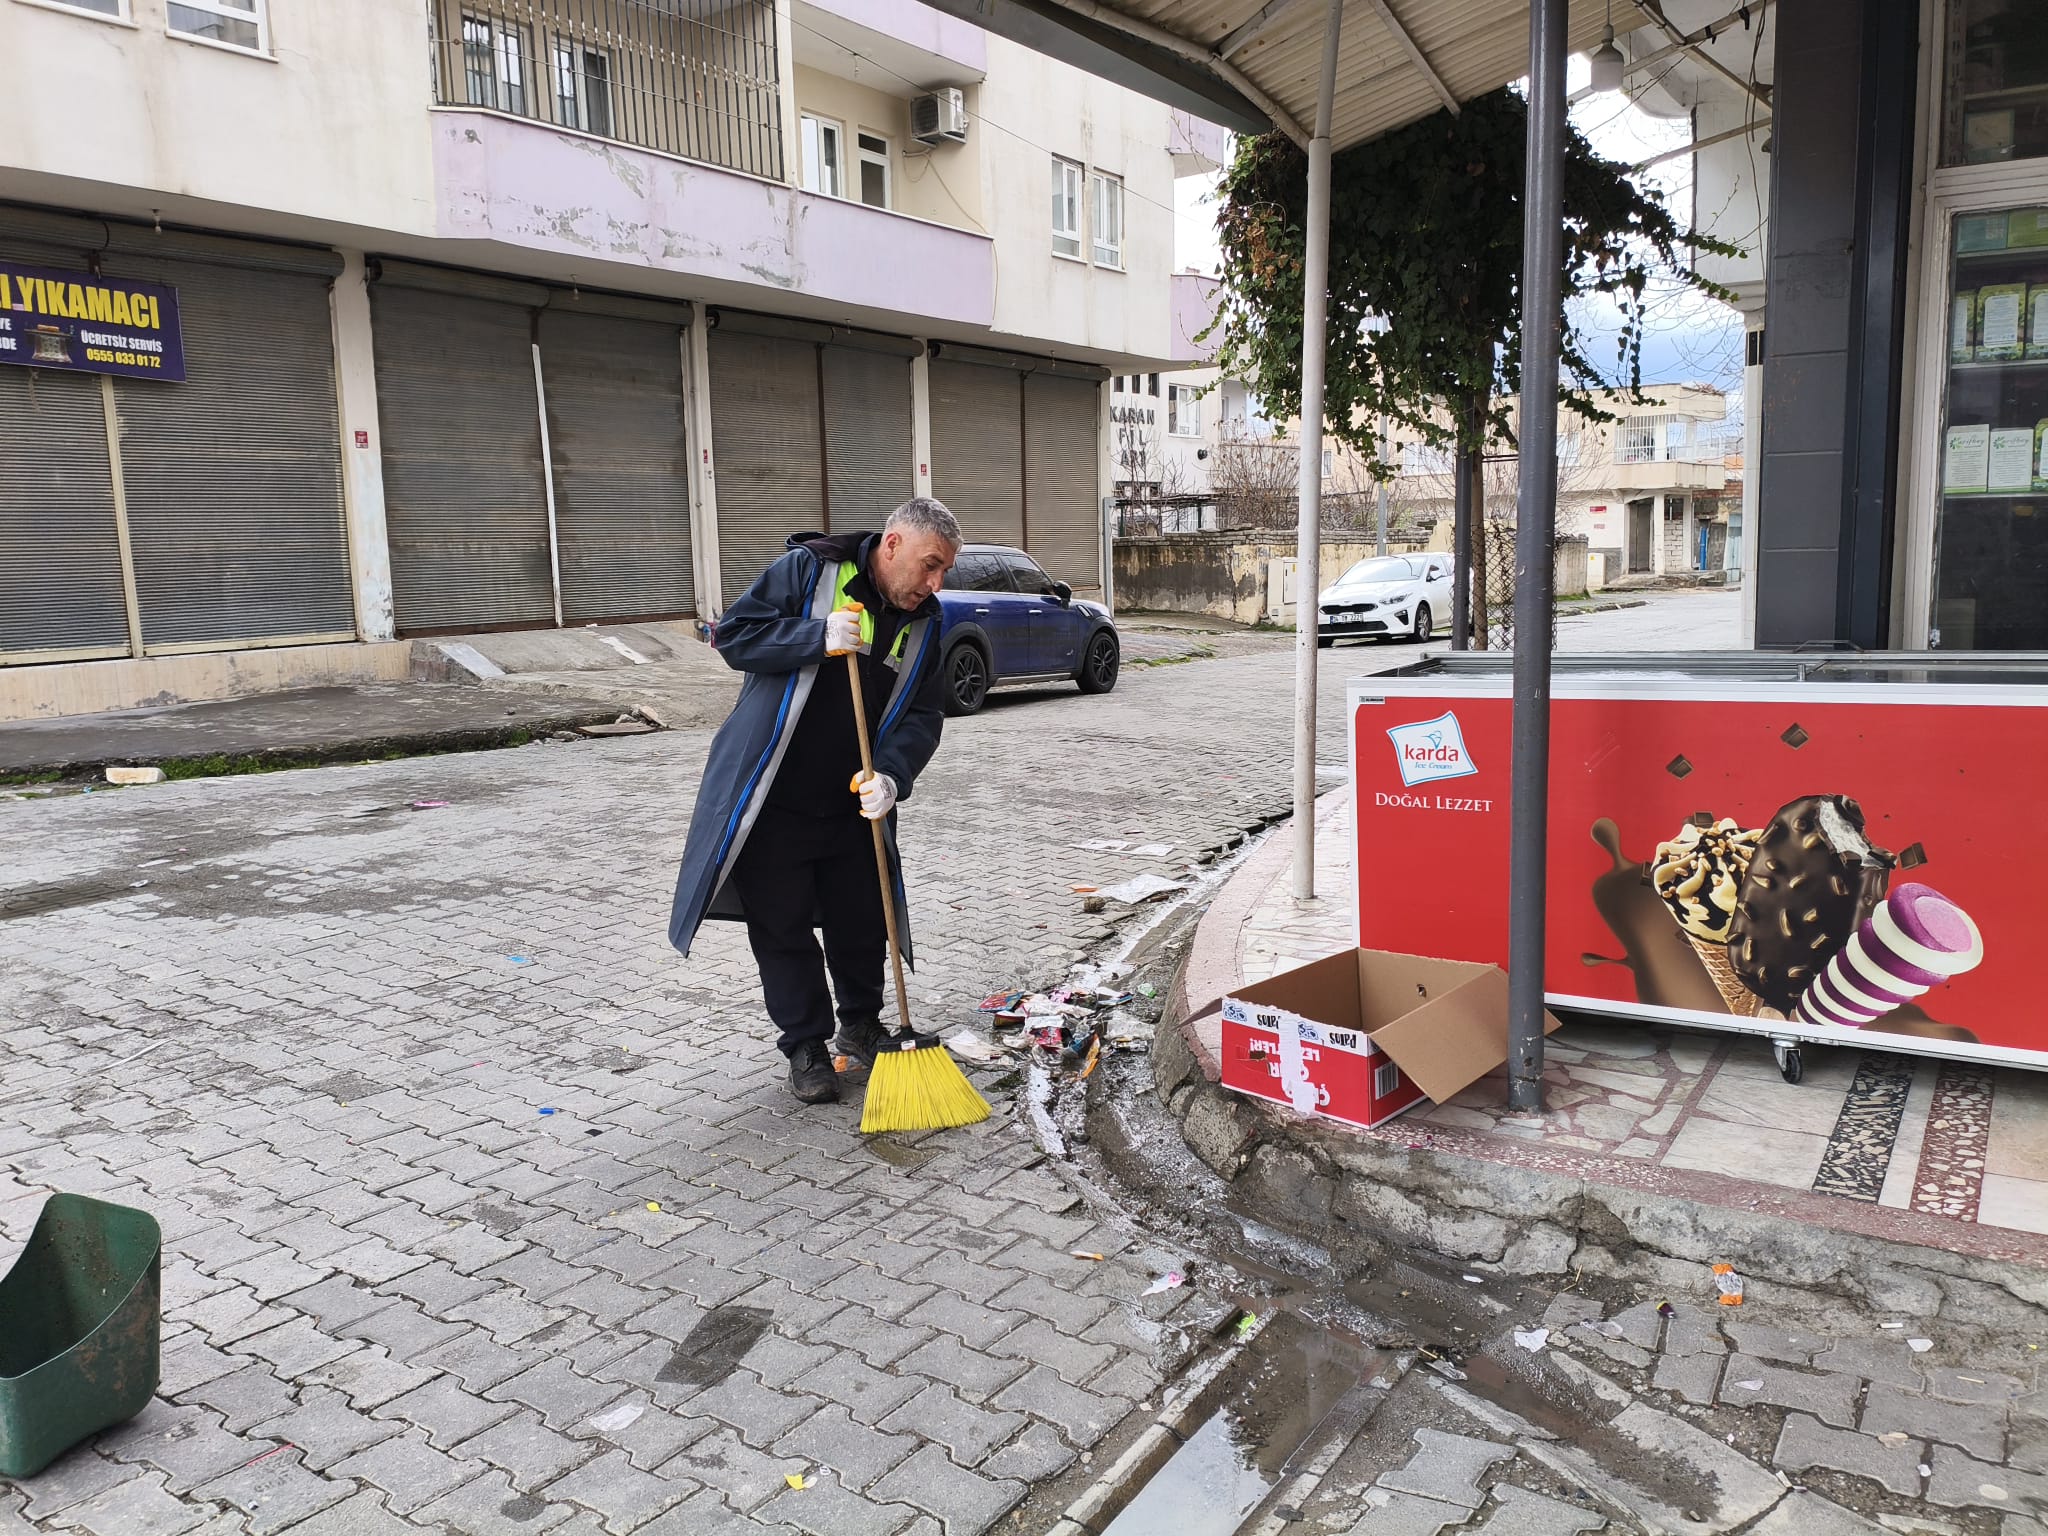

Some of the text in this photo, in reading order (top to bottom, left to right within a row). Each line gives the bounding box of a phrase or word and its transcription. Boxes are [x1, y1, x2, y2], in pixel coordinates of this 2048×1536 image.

[16, 275, 160, 330] YIKAMACI
[86, 348, 114, 362] 0555
[115, 351, 135, 365] 033
[149, 356, 161, 368] 72
[1404, 744, 1459, 762] karda
[1375, 792, 1493, 812] DOĞAL LEZZET
